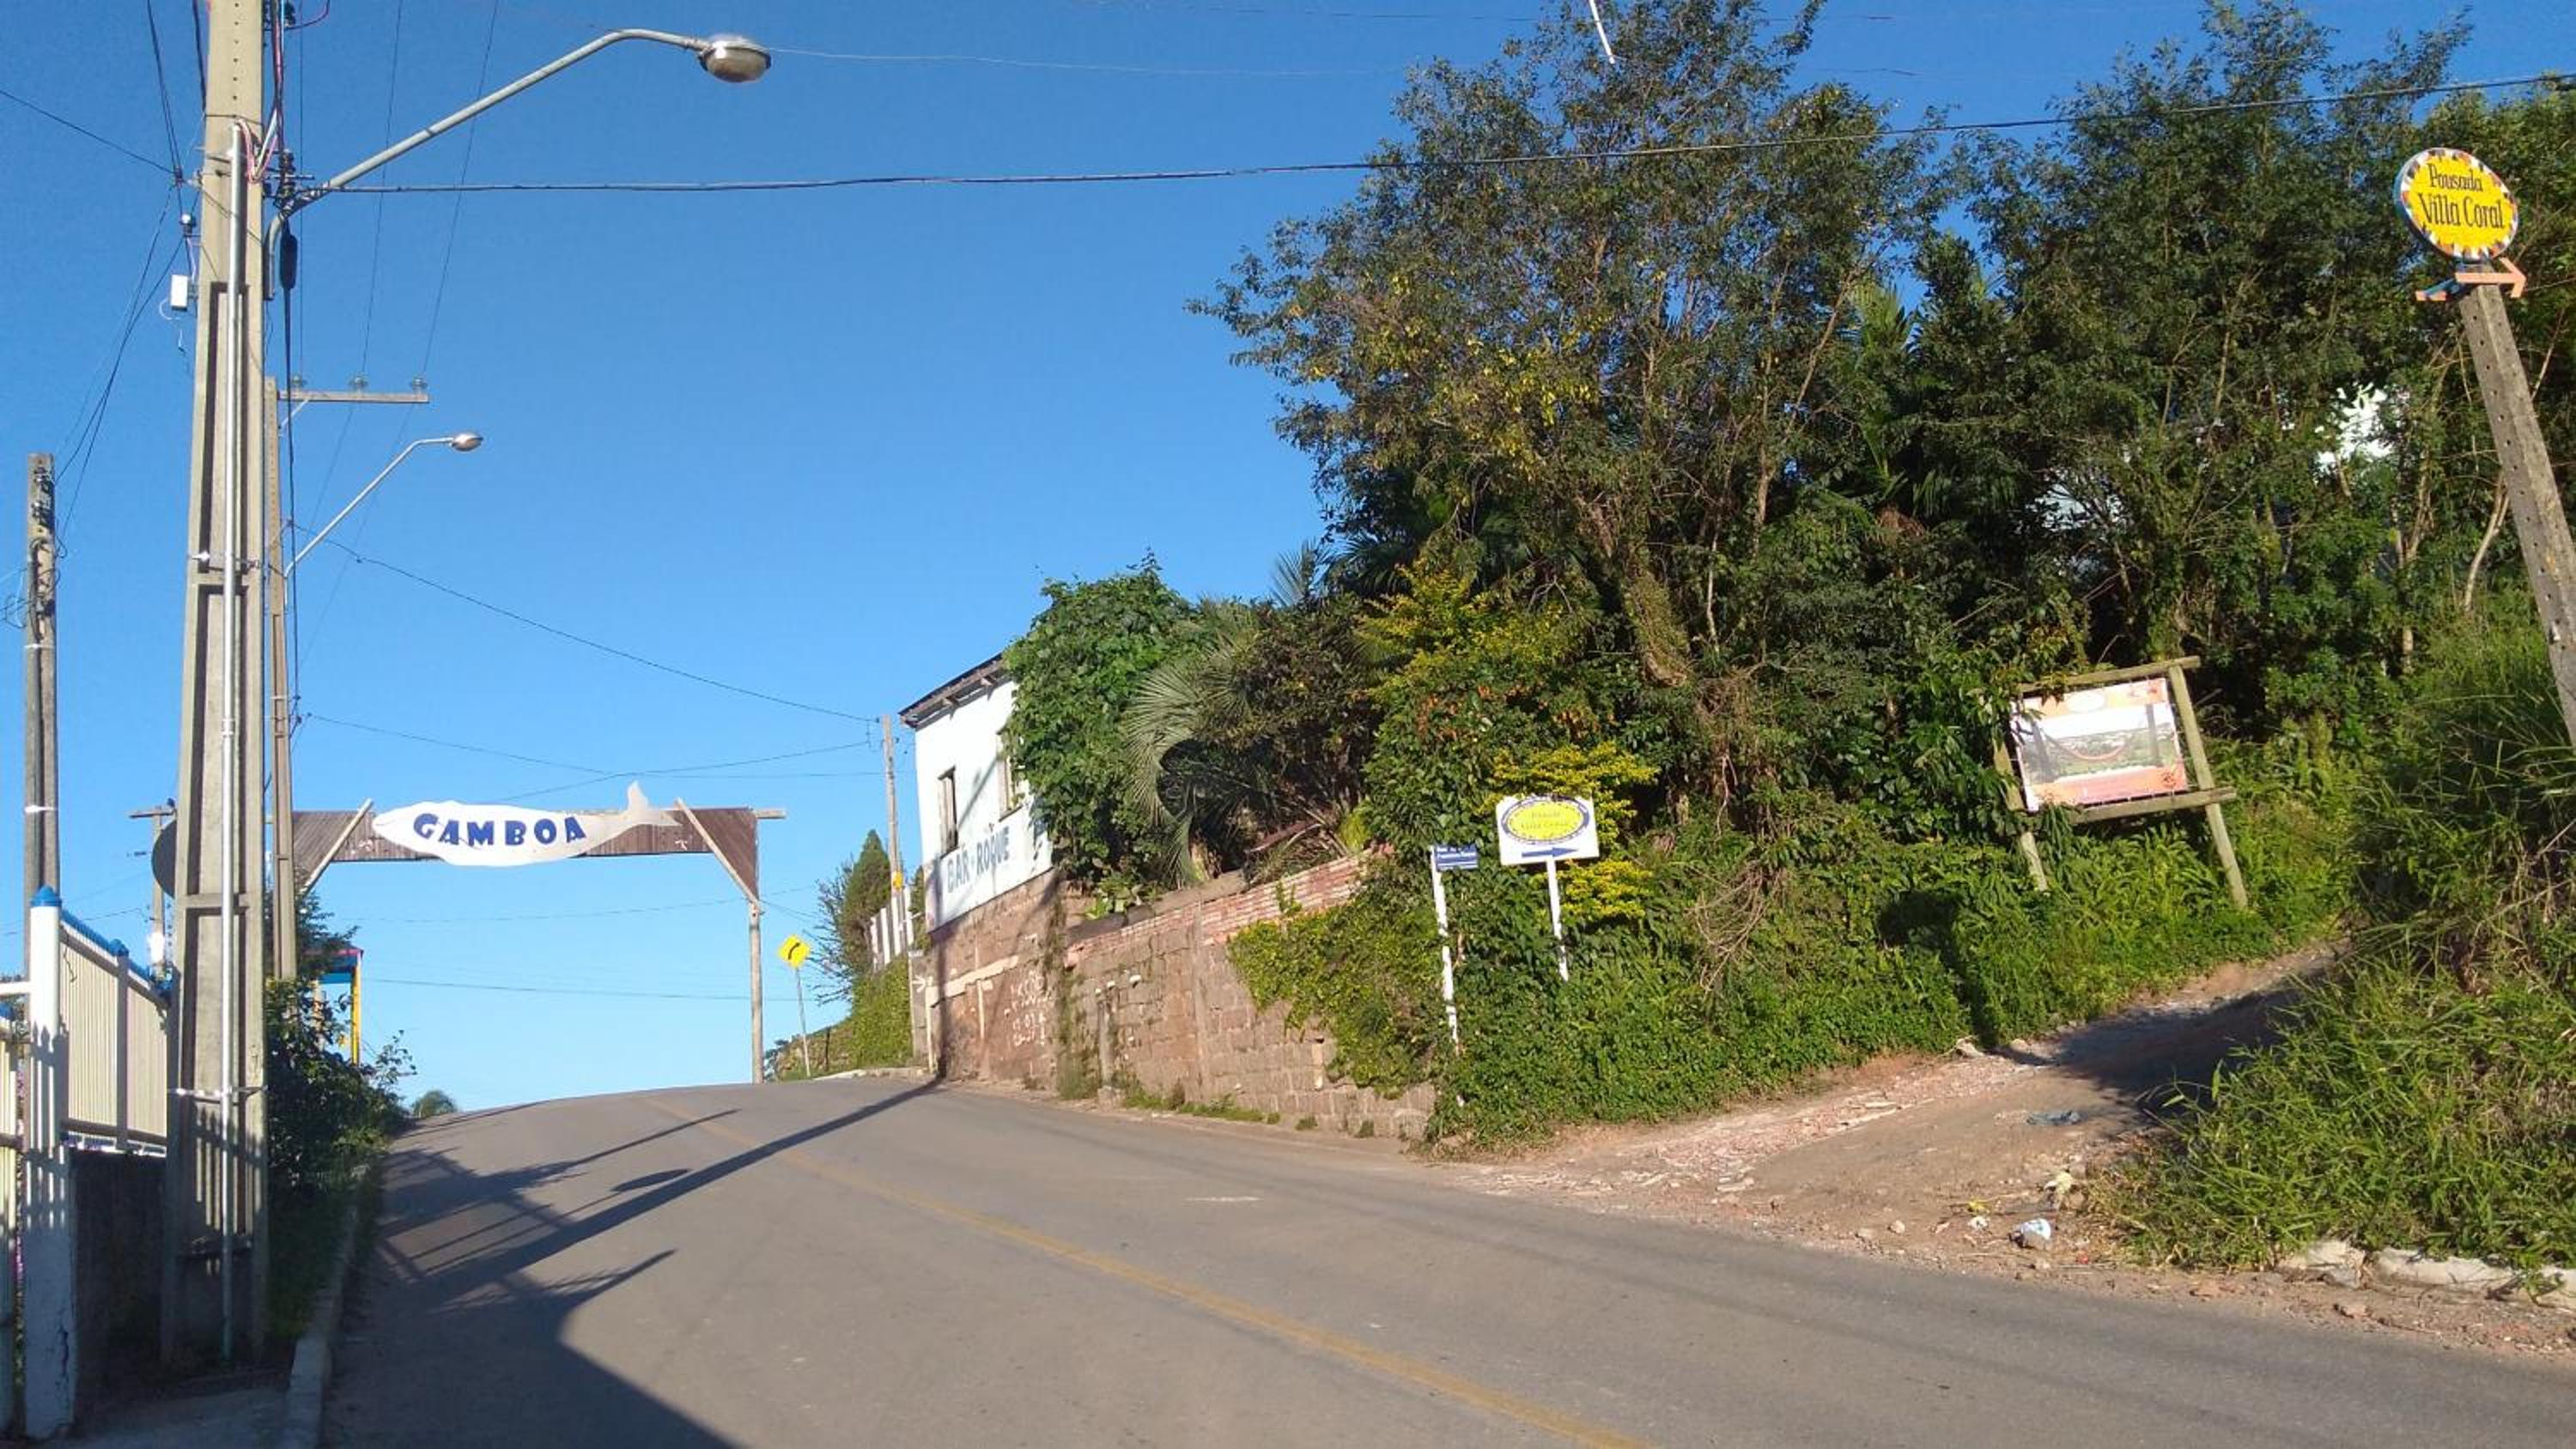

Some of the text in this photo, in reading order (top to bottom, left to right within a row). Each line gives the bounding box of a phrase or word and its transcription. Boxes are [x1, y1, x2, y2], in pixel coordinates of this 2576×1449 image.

[2427, 162, 2483, 191] Pousada
[2418, 192, 2505, 228] Villa Coral
[413, 812, 586, 846] GAMBOA
[947, 825, 1010, 893] BAR ROQUE
